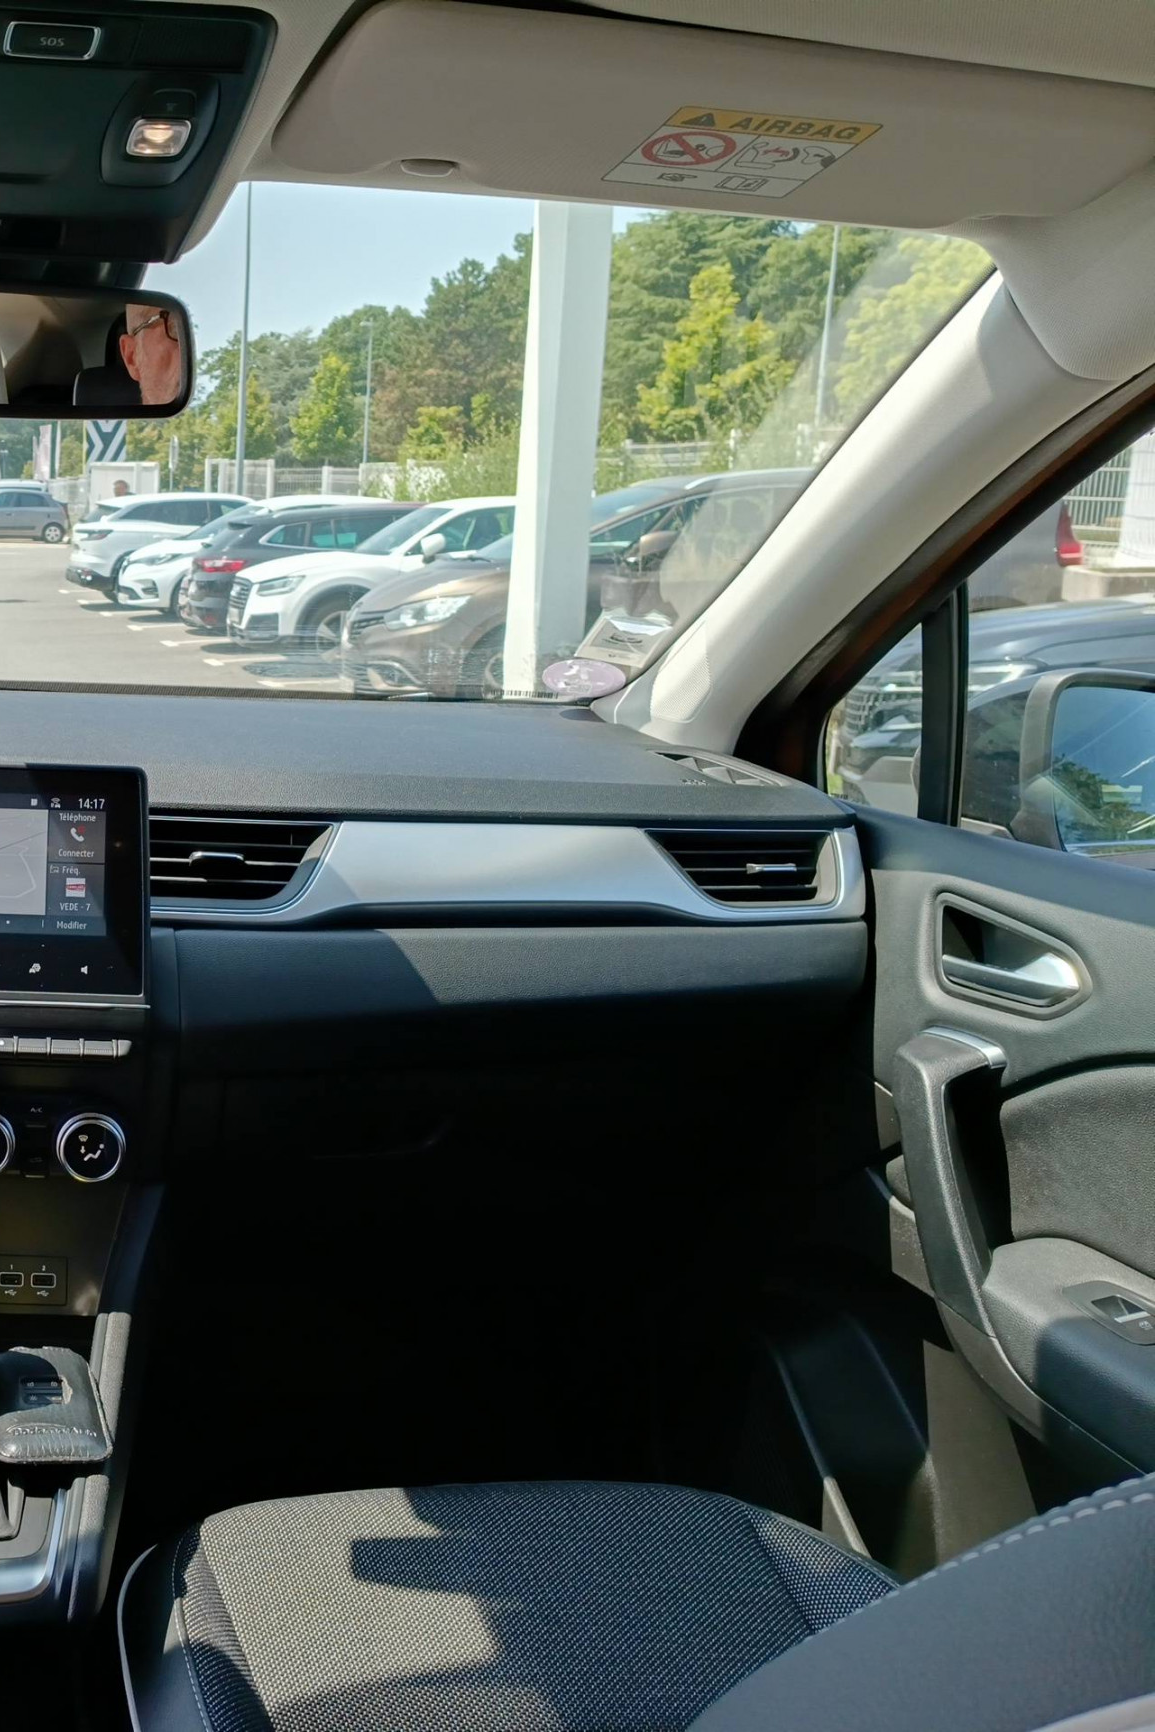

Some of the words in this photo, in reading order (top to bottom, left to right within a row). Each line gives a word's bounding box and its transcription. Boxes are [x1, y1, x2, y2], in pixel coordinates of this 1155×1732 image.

[40, 37, 65, 47] SOS
[729, 116, 862, 140] AIRBAG
[78, 798, 105, 809] 14:17
[59, 812, 96, 823] Téléphone
[58, 848, 95, 858] Connecter
[62, 865, 81, 876] Fréq.
[59, 902, 78, 911] VEDE
[56, 921, 87, 930] Modifier
